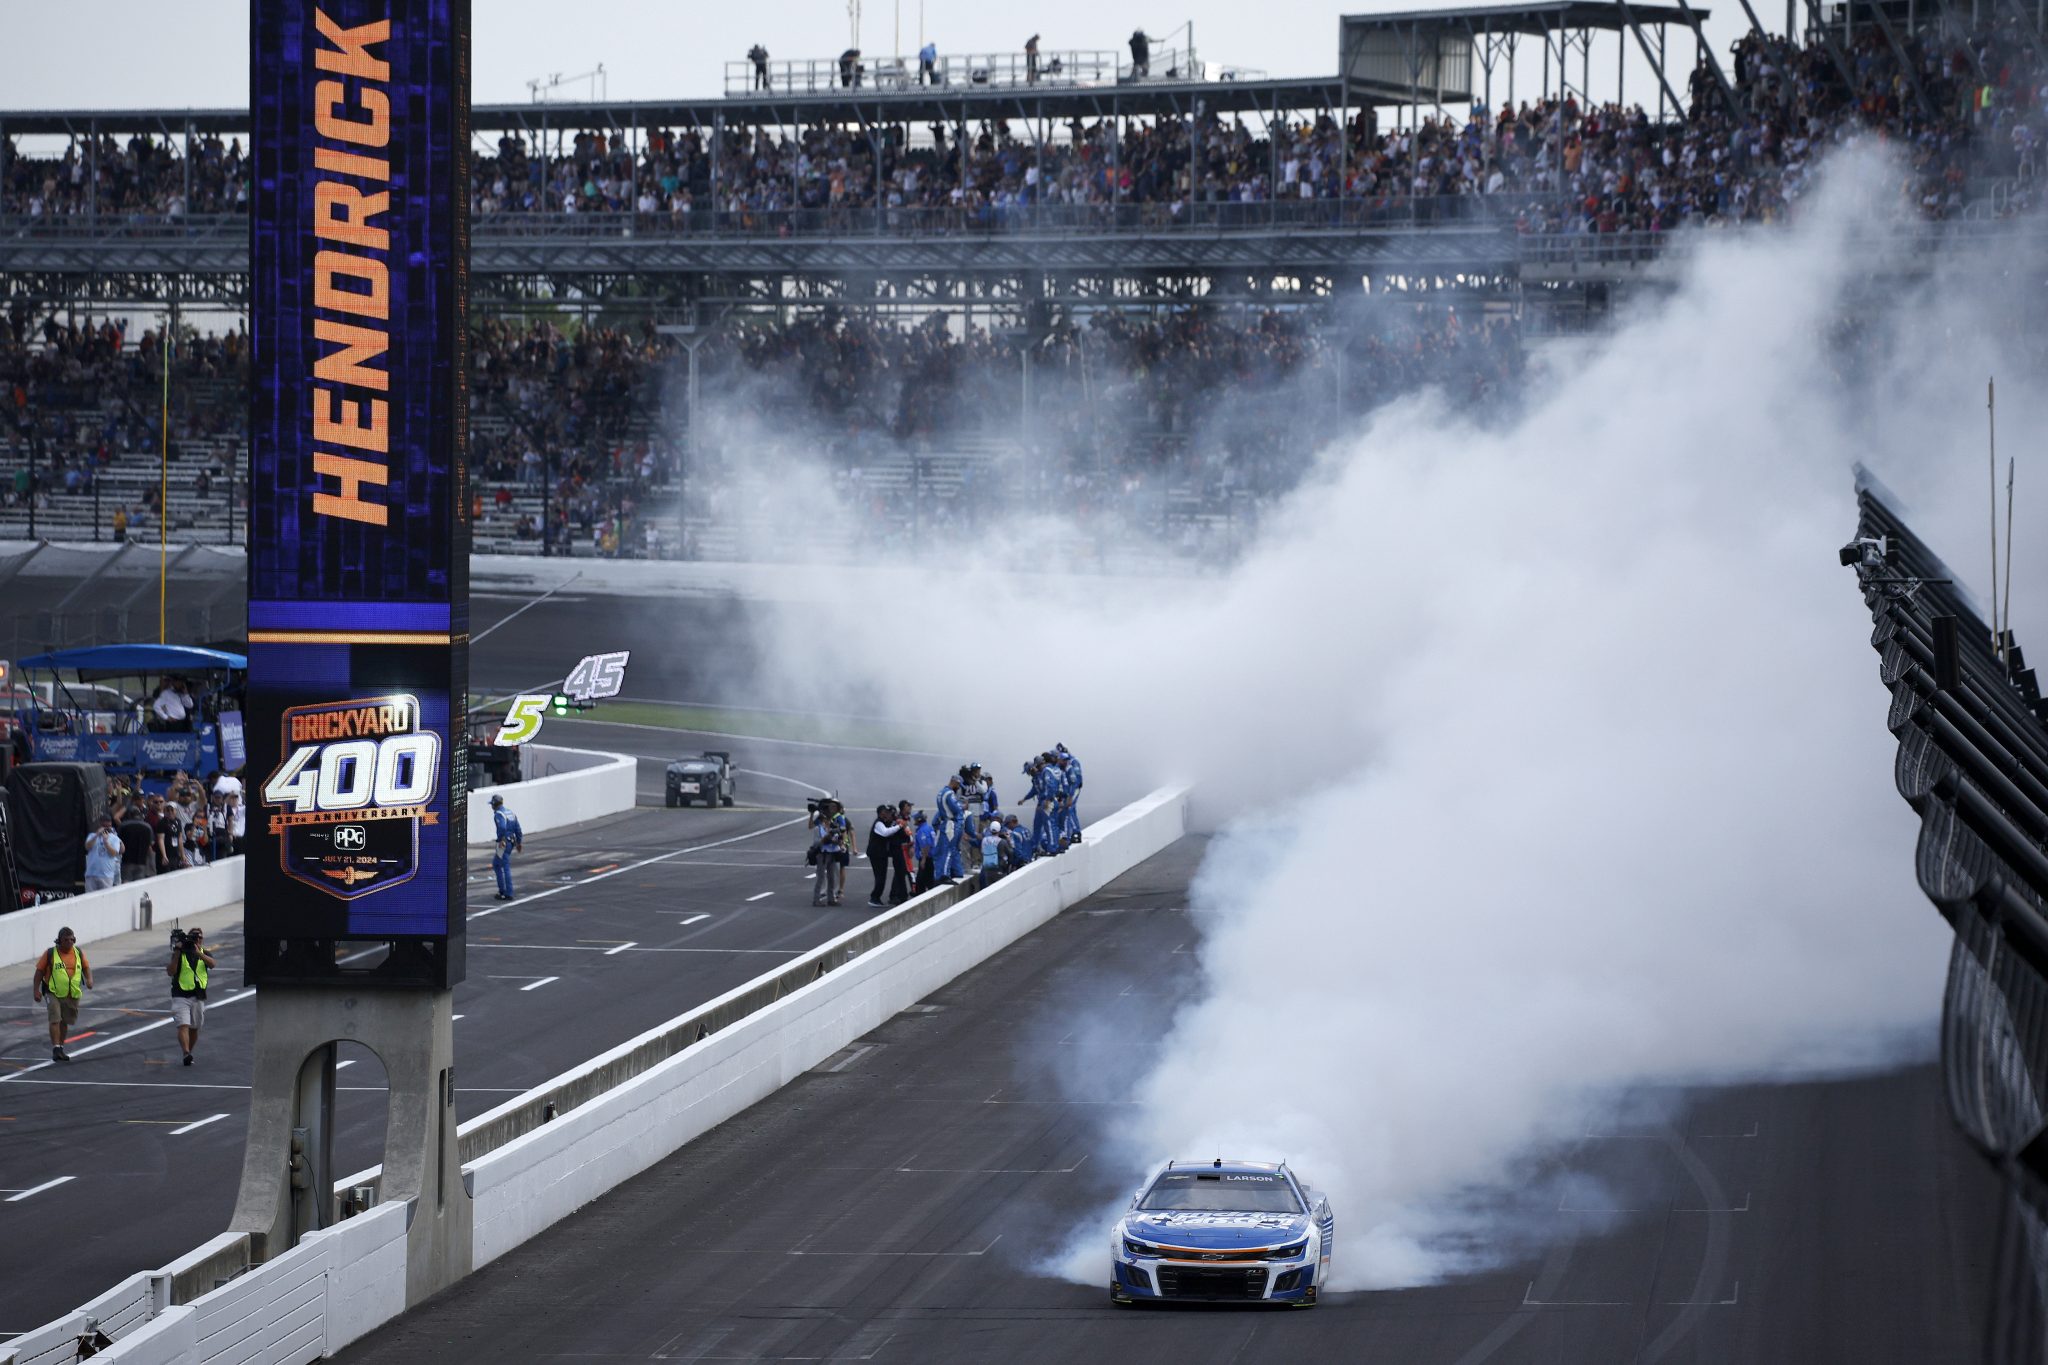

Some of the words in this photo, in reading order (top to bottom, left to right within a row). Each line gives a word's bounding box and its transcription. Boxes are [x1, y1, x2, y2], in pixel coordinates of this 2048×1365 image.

[313, 5, 391, 527] HENDRICK
[564, 652, 630, 700] 45
[291, 702, 409, 742] BRICKYARD
[497, 697, 550, 745] 5
[143, 740, 190, 754] Hendrick
[264, 735, 437, 812] 400
[313, 807, 419, 822] ANNIVERSARY
[336, 828, 364, 848] PPG
[323, 855, 342, 864] JULY
[356, 856, 378, 865] 2024
[39, 890, 75, 899] TOYOTA
